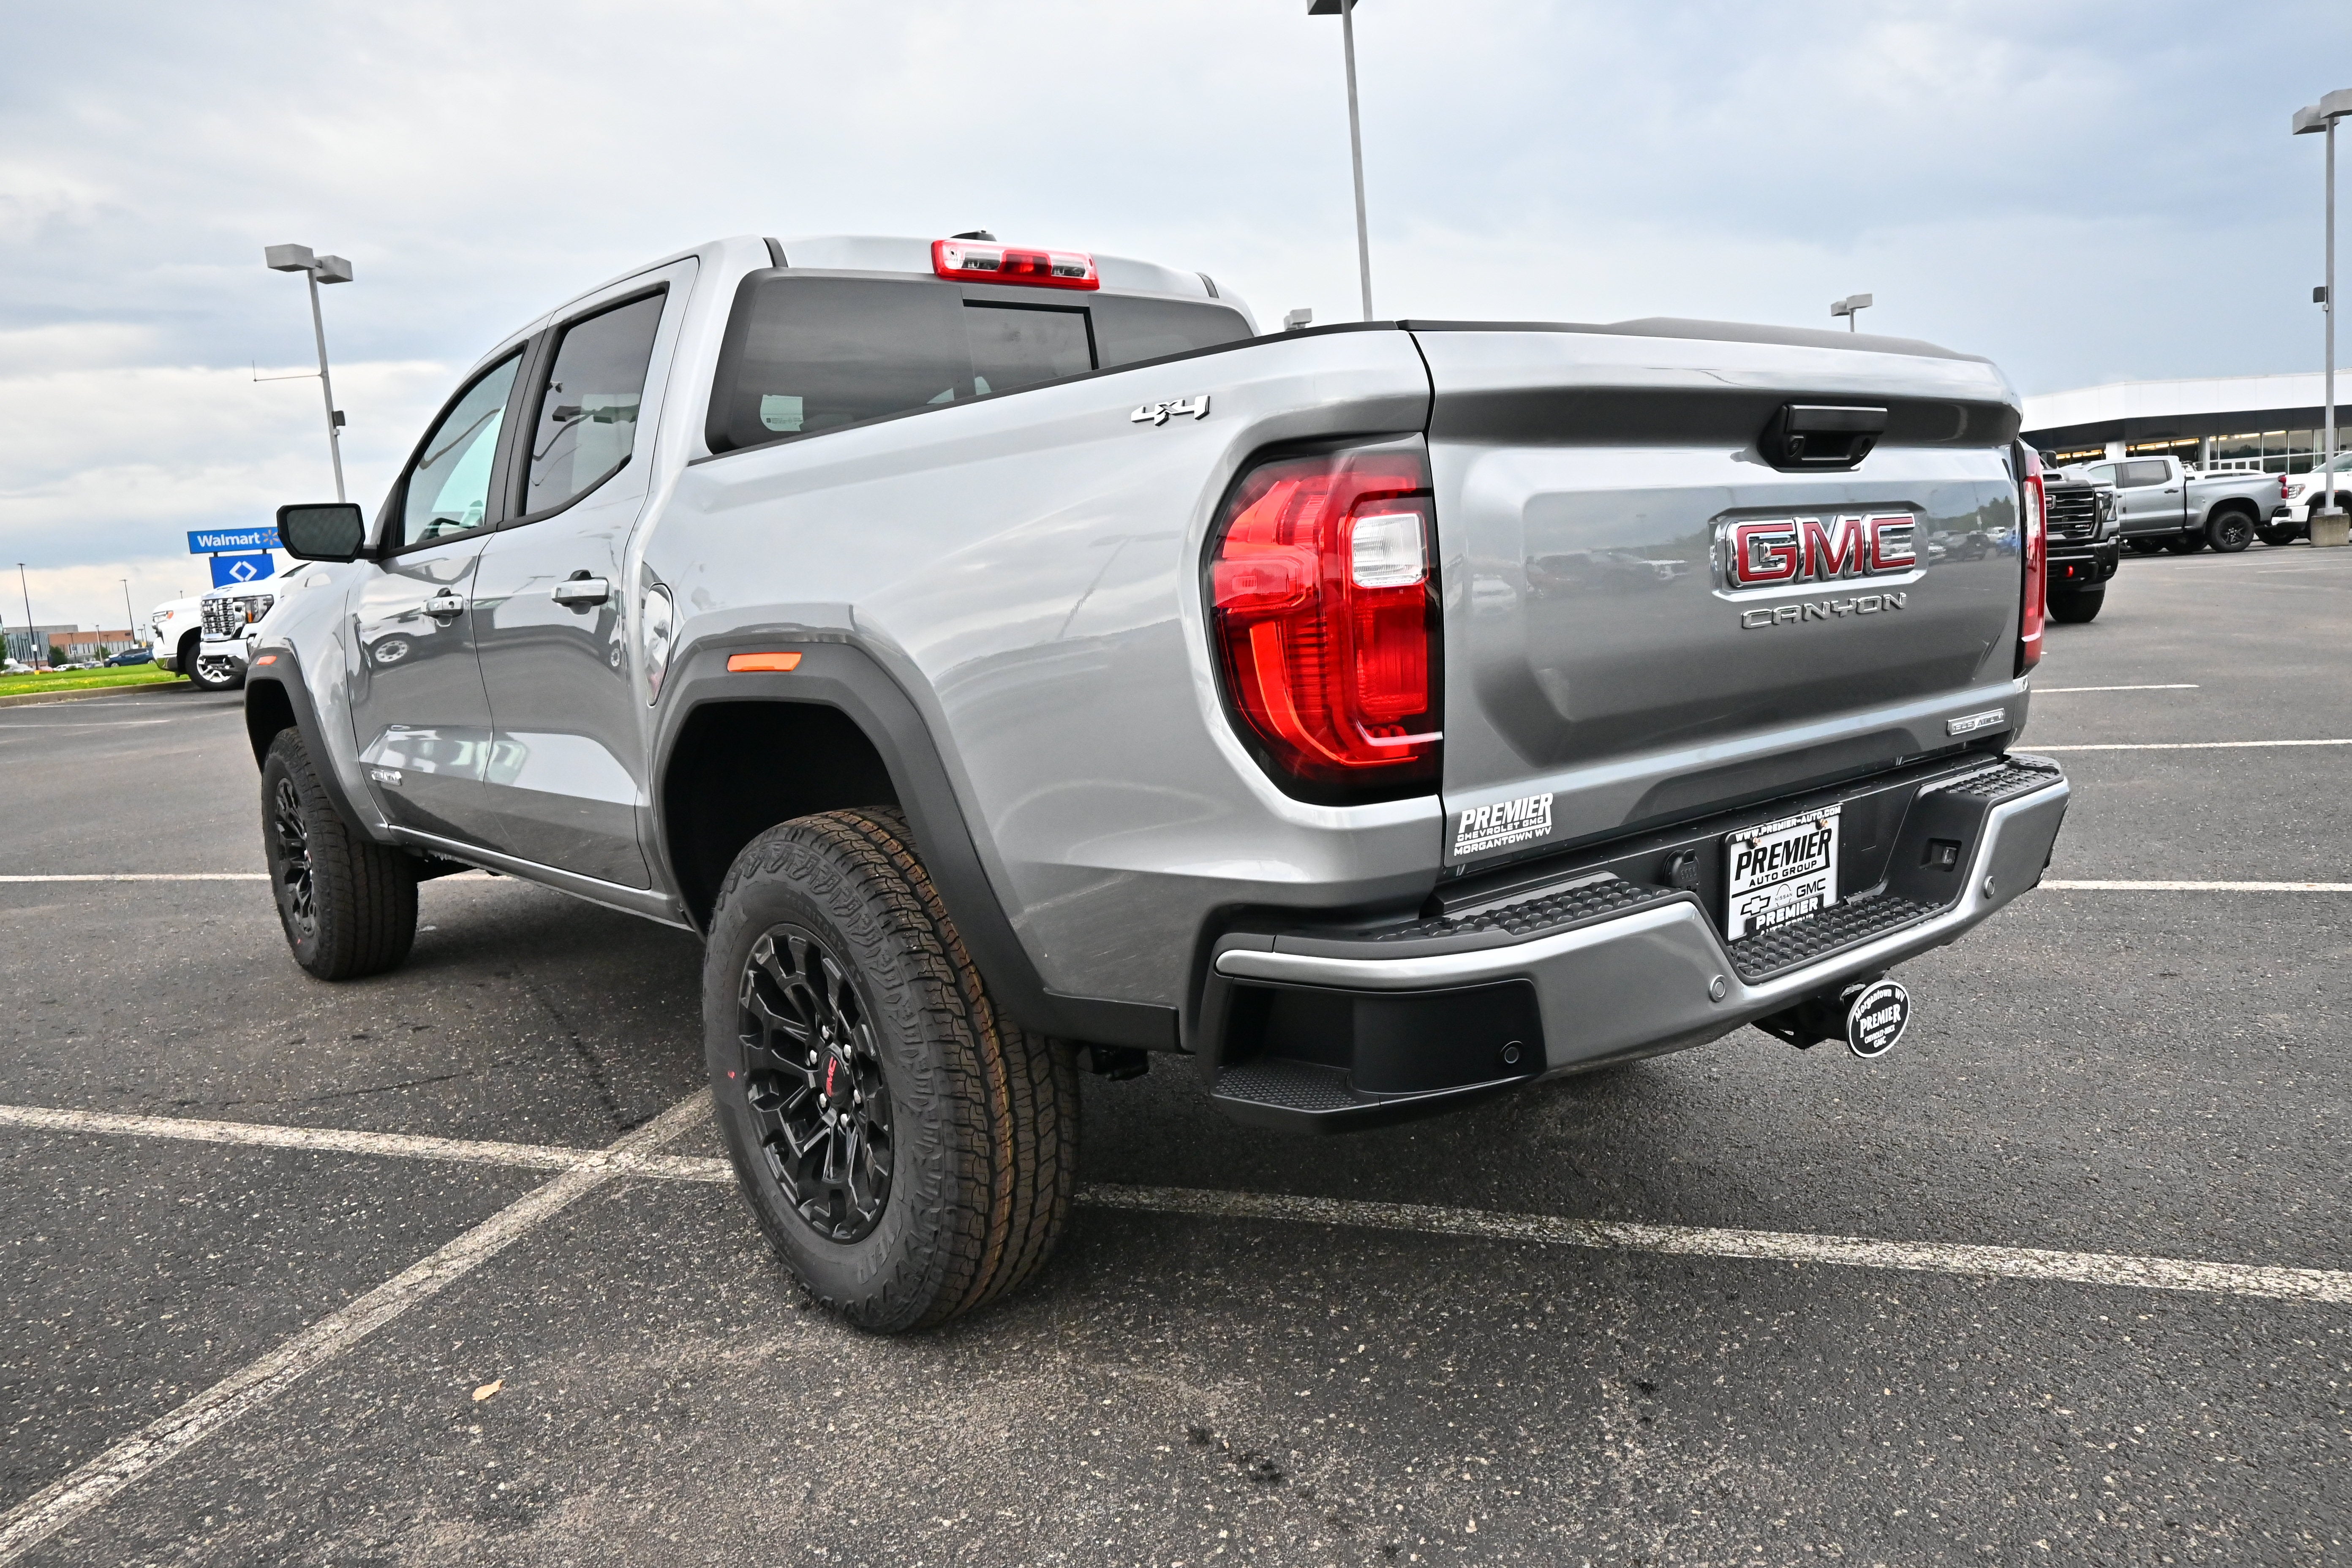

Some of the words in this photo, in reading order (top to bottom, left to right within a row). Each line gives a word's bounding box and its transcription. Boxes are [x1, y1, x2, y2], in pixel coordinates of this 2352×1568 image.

[197, 532, 261, 547] Walmart
[1726, 513, 1916, 588] GMC
[1741, 592, 1907, 629] CANYON
[1457, 822, 1519, 842] CHEVROLET
[1523, 816, 1544, 827] GMC
[1458, 792, 1553, 833] PREMIER
[1735, 806, 1841, 842] WWW.PREMIER-AUTO.COM
[1454, 831, 1533, 856] MORGANTOWN
[1535, 826, 1552, 837] WV
[1735, 828, 1832, 881] PREMIER
[1749, 872, 1778, 887] AUTO
[1782, 860, 1817, 877] GROUP
[1797, 878, 1826, 898] GMC
[1756, 897, 1818, 930] PREMIER
[1775, 893, 1792, 902] NISSAN
[1855, 988, 1892, 1022] Morgantown
[1895, 988, 1906, 1002] WV
[1859, 1004, 1901, 1038] PREMIER
[1873, 1036, 1886, 1048] GMC
